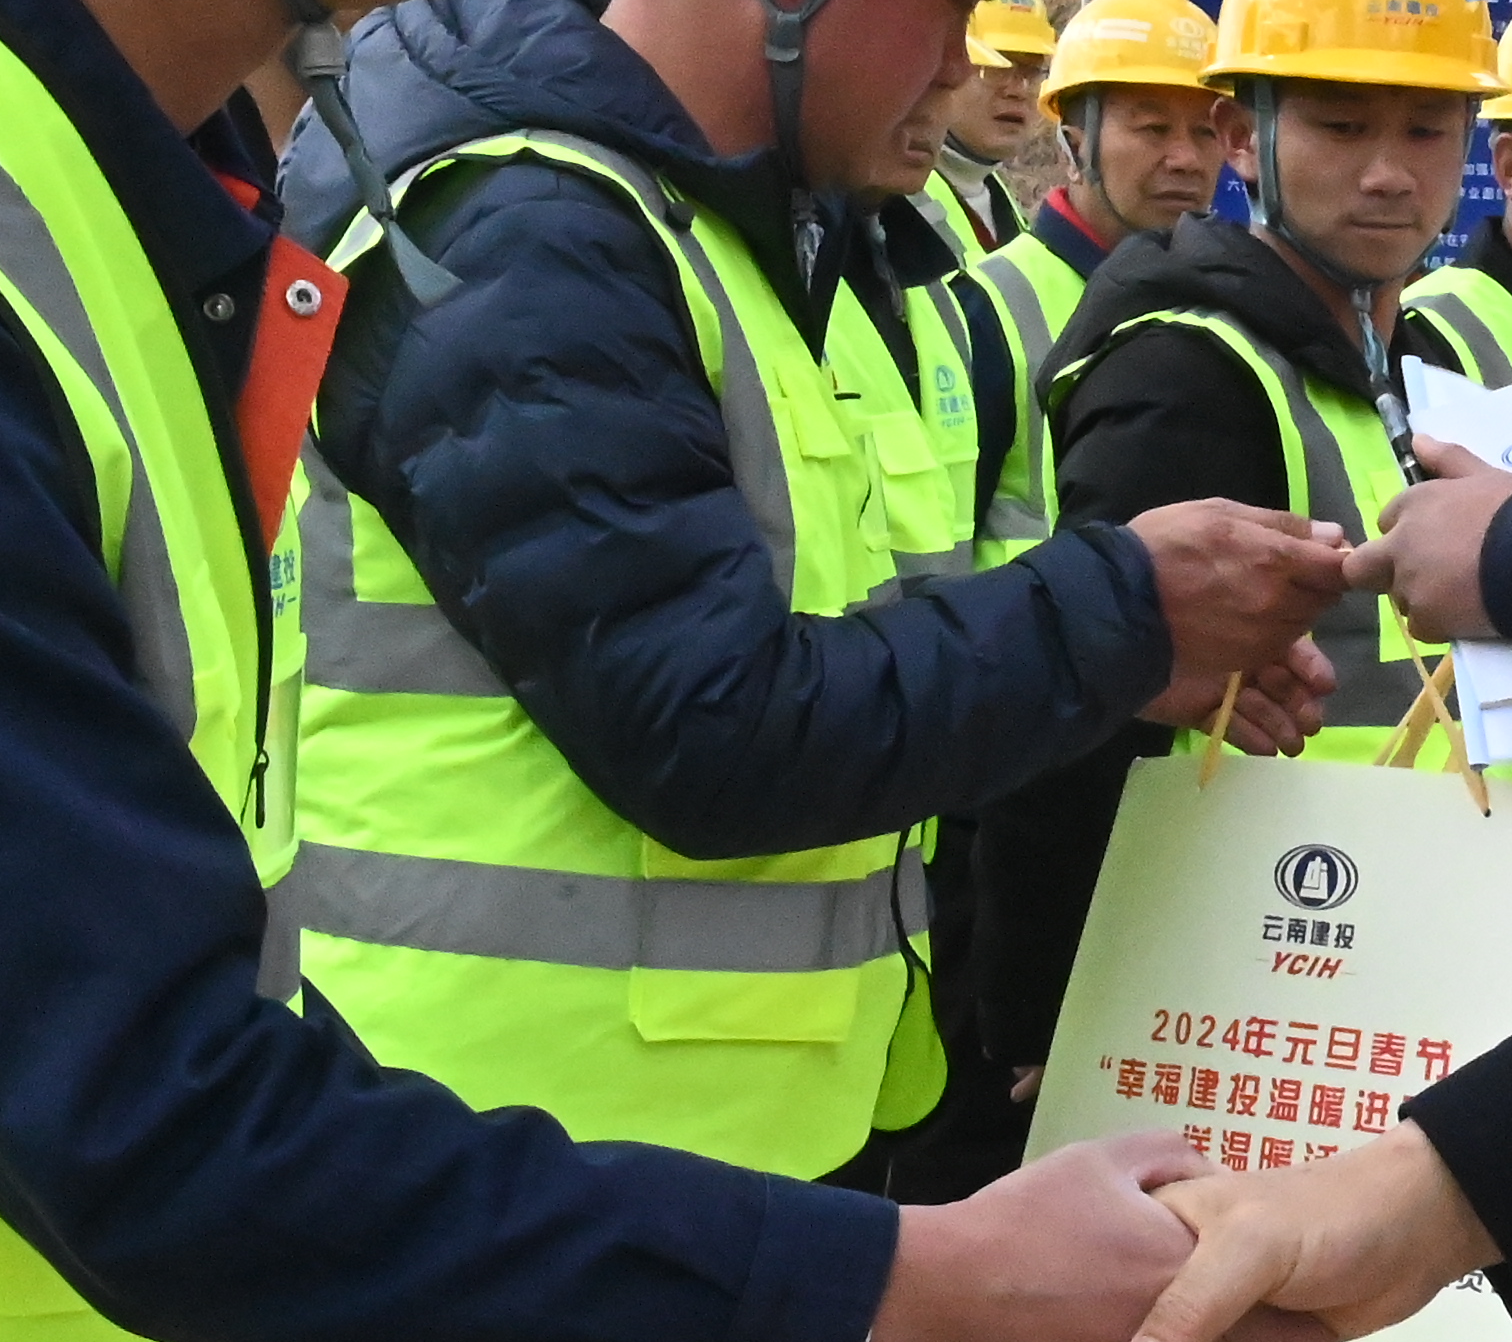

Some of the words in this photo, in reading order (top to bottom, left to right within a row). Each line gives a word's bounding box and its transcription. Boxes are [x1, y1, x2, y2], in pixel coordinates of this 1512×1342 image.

[1262, 916, 1355, 949] 云南建投
[1271, 952, 1343, 979] YCIH
[1151, 1009, 1453, 1081] 2024年元旦春节
[1100, 1055, 1414, 1135] “幸福建投温暖进
